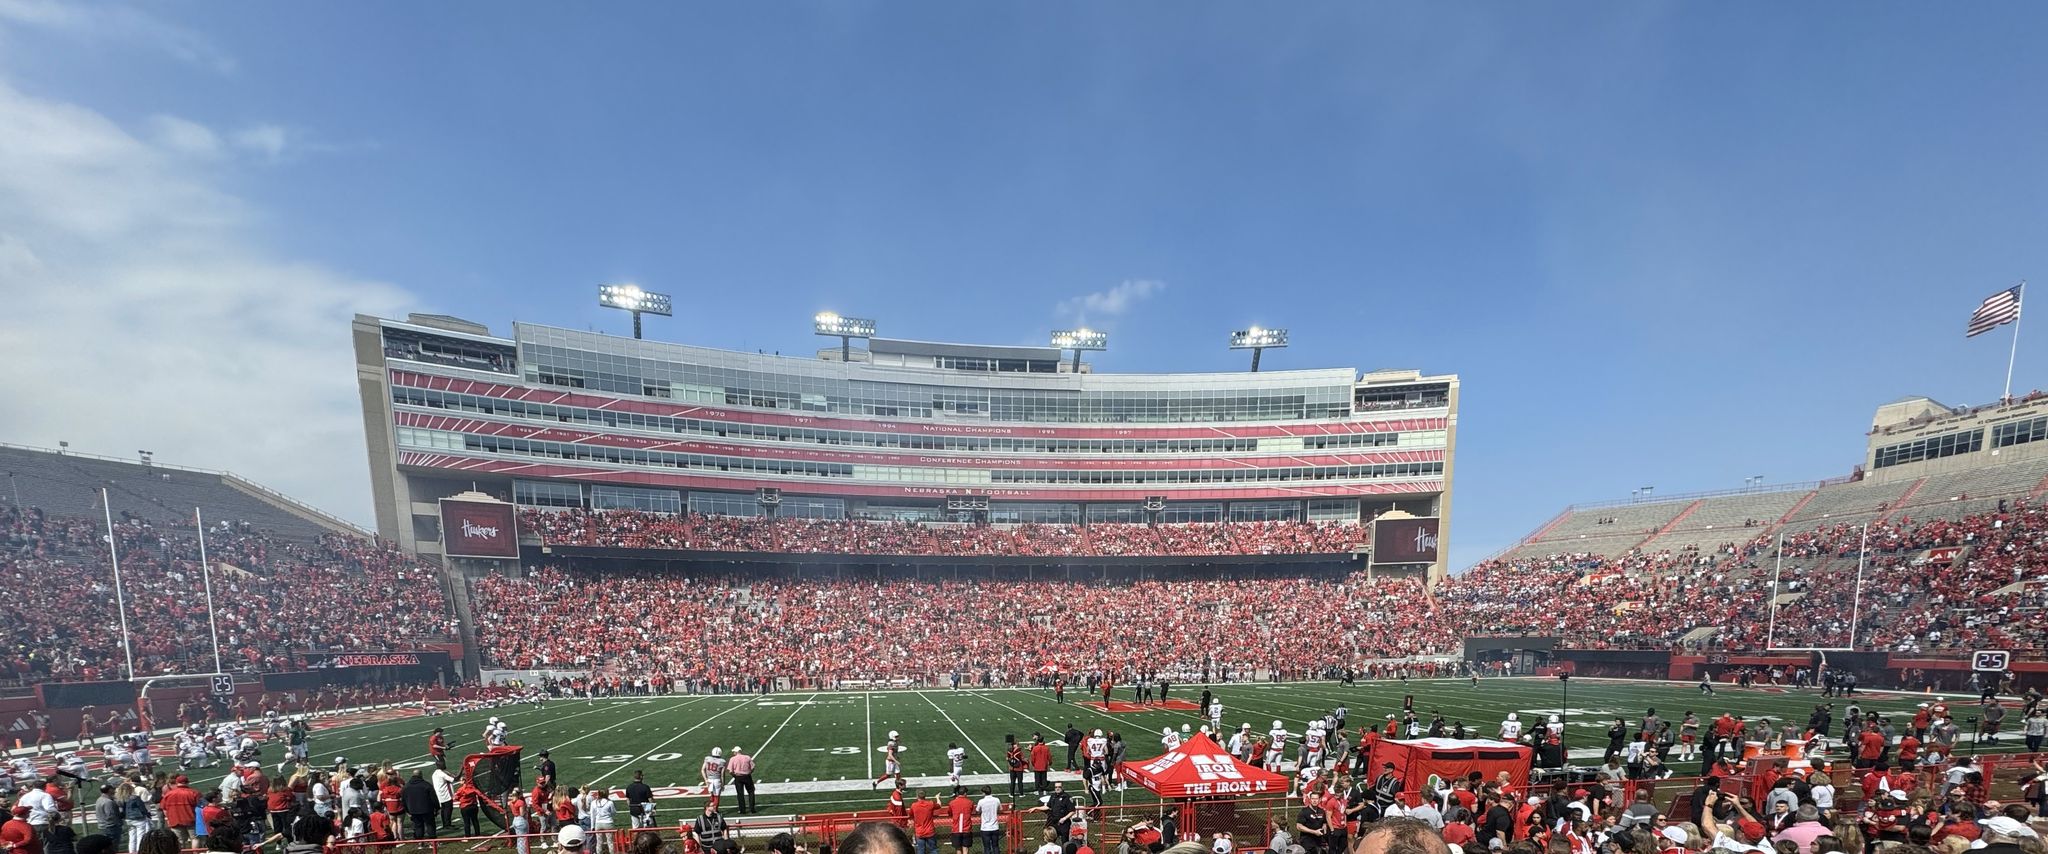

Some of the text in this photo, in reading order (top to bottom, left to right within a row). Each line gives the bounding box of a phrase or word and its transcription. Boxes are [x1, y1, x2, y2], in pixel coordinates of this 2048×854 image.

[461, 518, 499, 540] Huskers
[338, 654, 420, 665] NEBRASKA
[1978, 654, 2002, 667] 25
[215, 676, 231, 692] 25
[1091, 743, 1102, 752] 47
[1195, 764, 1237, 773] IRON
[1184, 780, 1267, 795] THE IRON N
